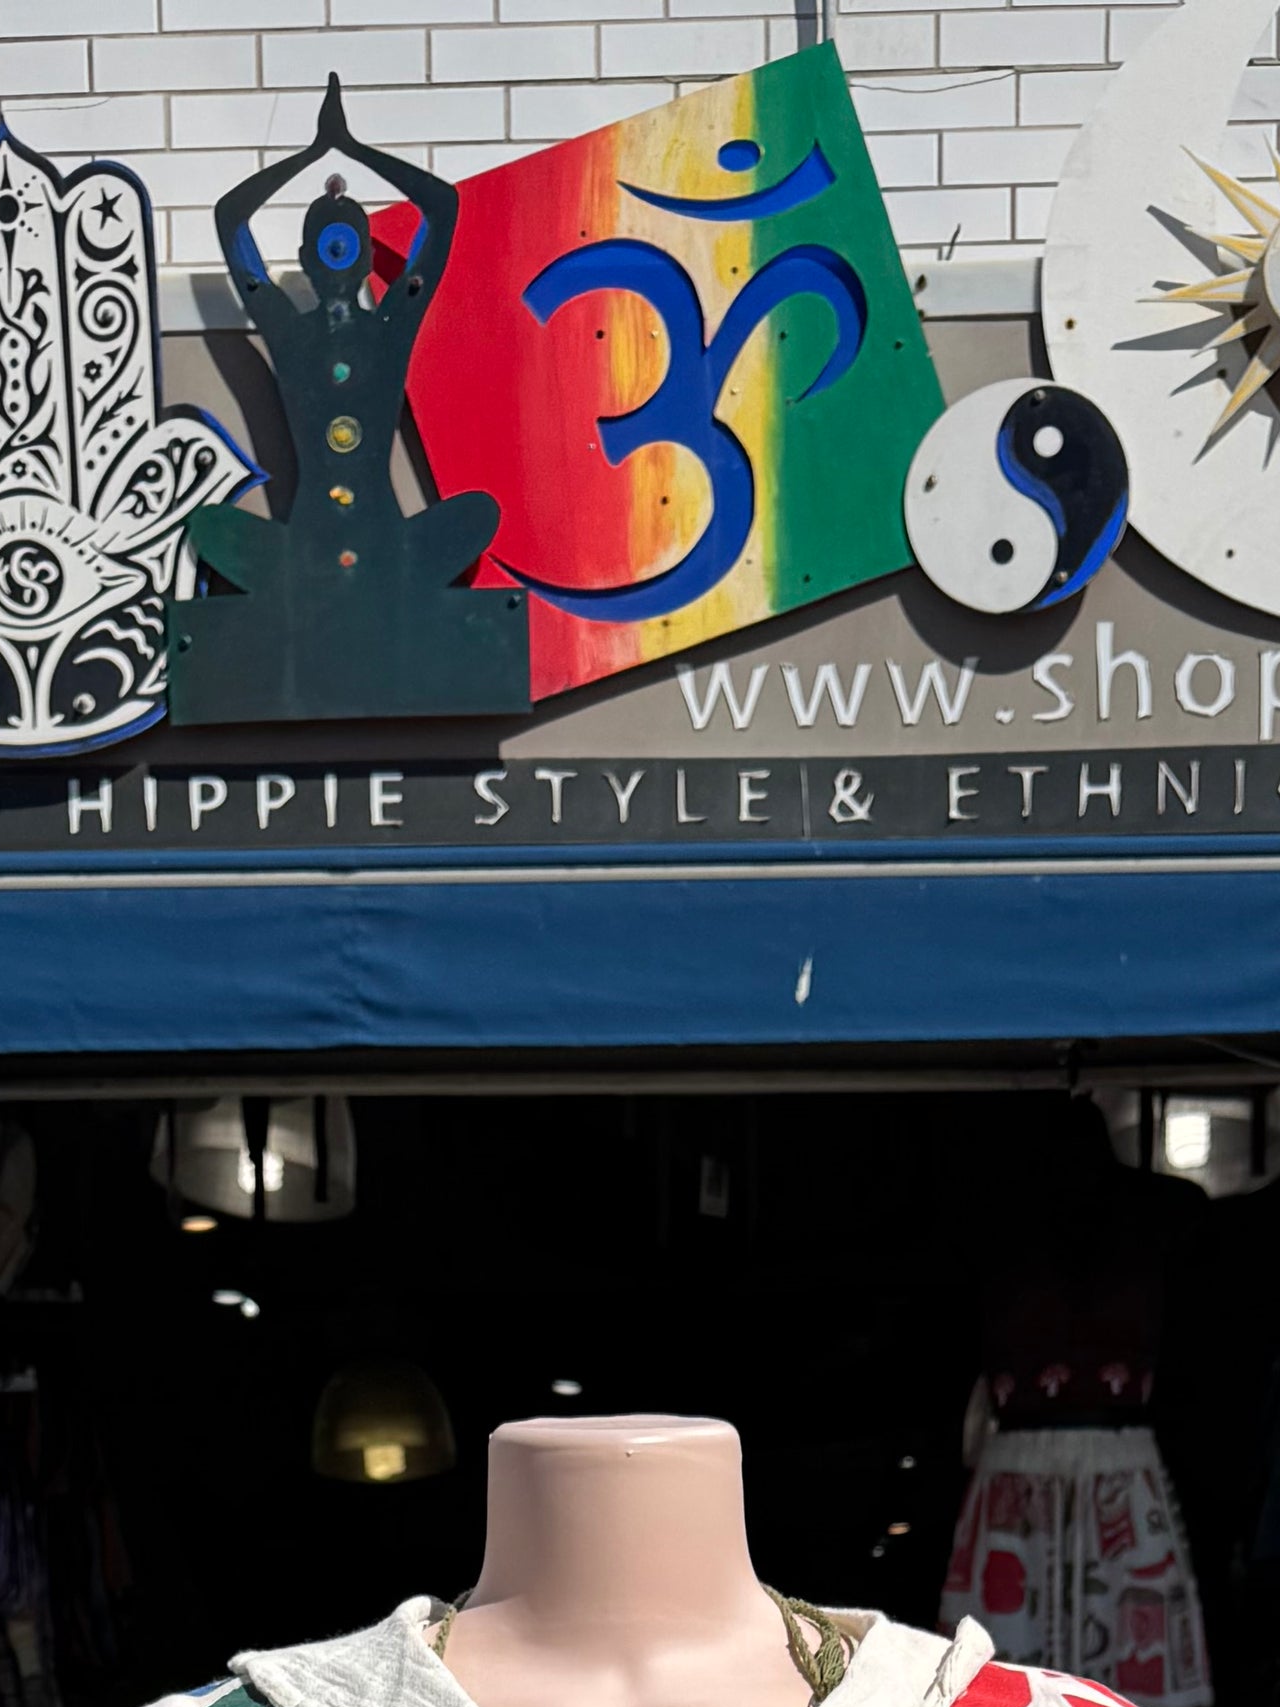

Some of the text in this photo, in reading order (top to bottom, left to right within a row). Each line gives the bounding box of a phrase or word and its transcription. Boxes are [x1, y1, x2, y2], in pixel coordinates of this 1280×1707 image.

[67, 771, 404, 834] HIPPIE
[473, 768, 773, 828] STYLE
[826, 769, 877, 823] &
